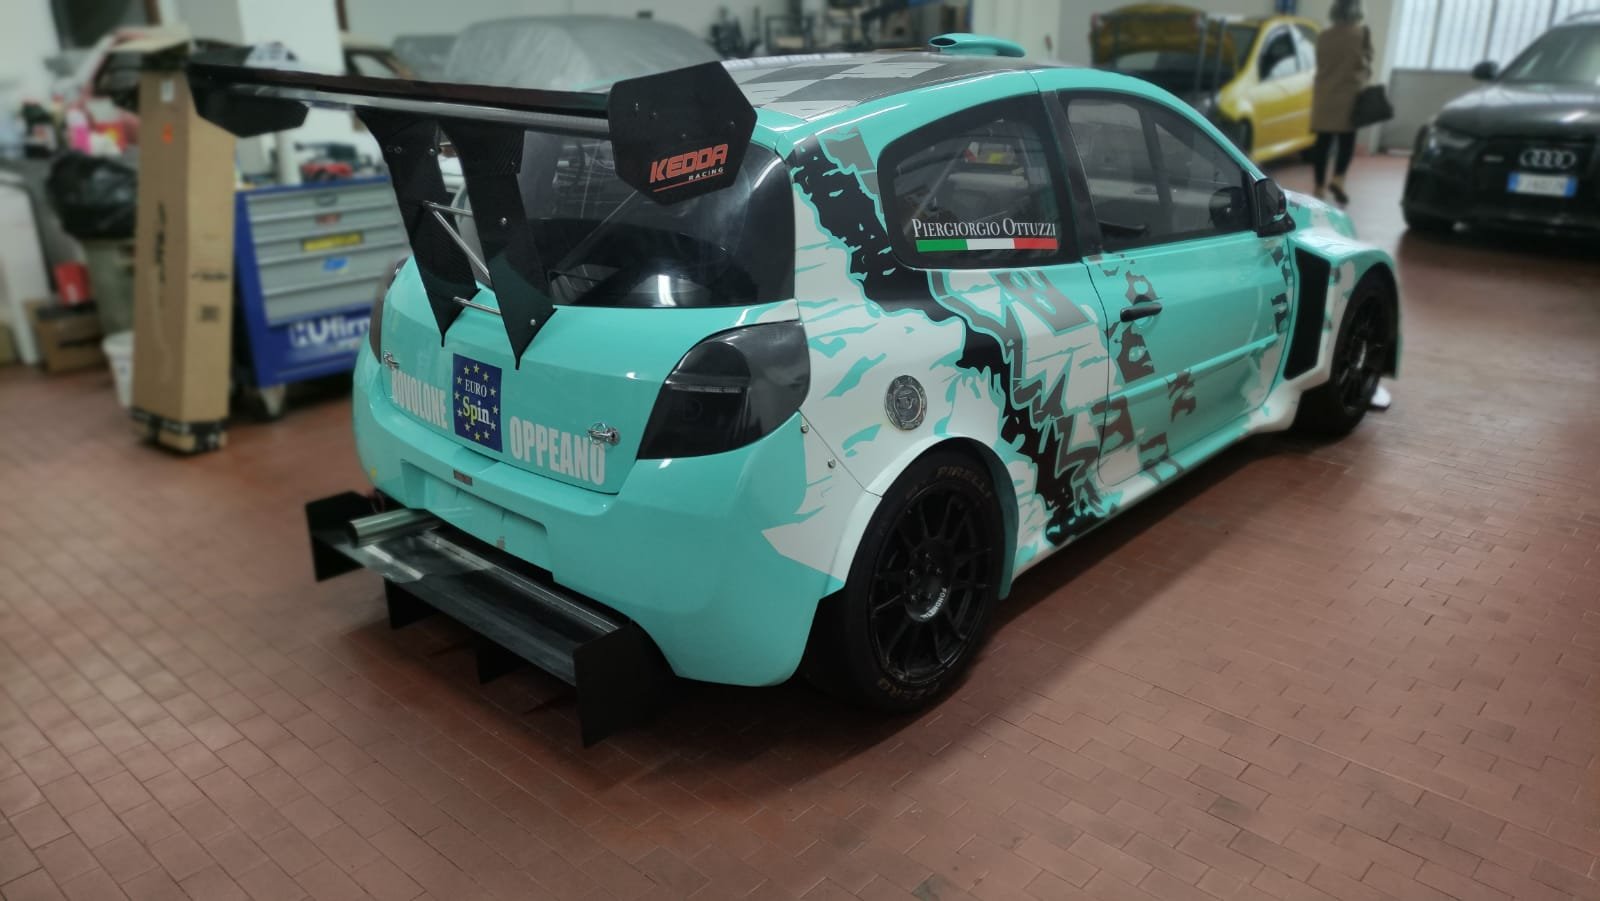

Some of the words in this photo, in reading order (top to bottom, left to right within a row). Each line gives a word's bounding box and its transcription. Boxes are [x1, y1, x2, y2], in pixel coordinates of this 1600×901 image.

[650, 143, 729, 183] KEDDA
[688, 167, 725, 181] RACING
[465, 379, 488, 398] EURO
[463, 396, 491, 426] Spin
[509, 415, 606, 485] OPPEANO
